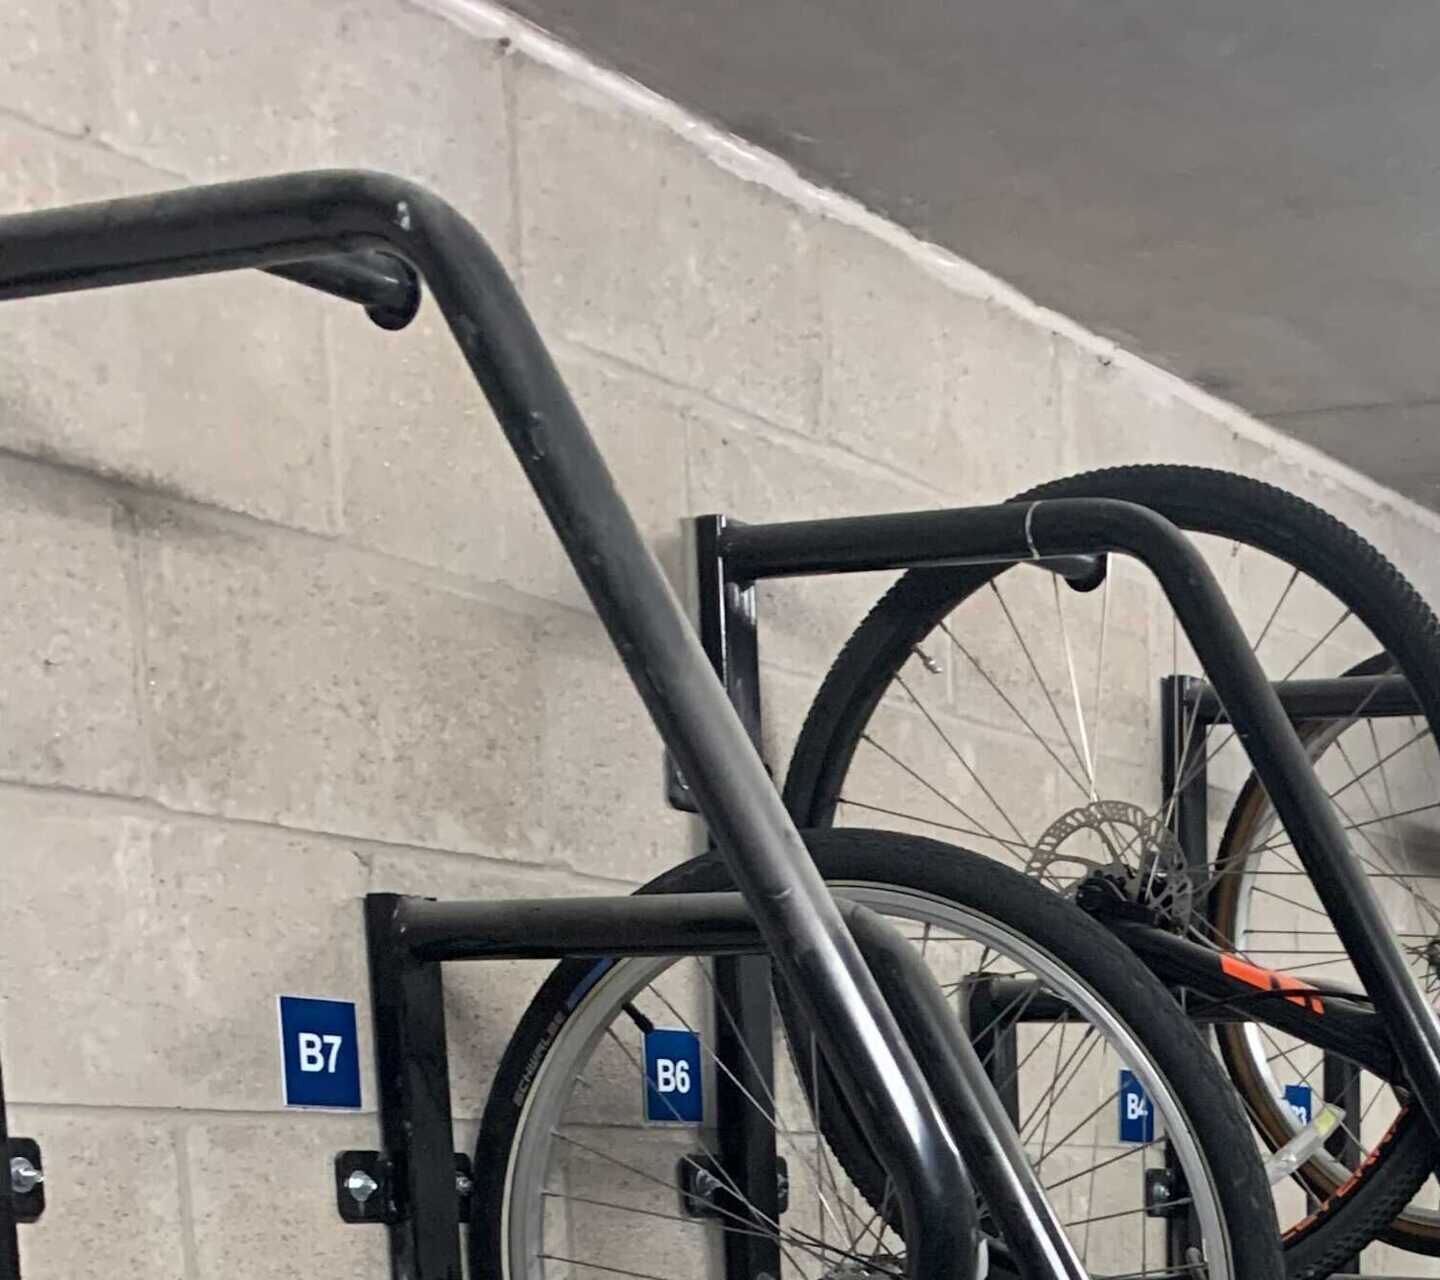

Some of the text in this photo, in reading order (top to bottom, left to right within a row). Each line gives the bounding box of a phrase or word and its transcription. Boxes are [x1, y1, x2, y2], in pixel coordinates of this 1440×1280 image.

[298, 1032, 343, 1073] B7
[656, 1058, 690, 1094] B6
[1127, 1093, 1149, 1120] B4
